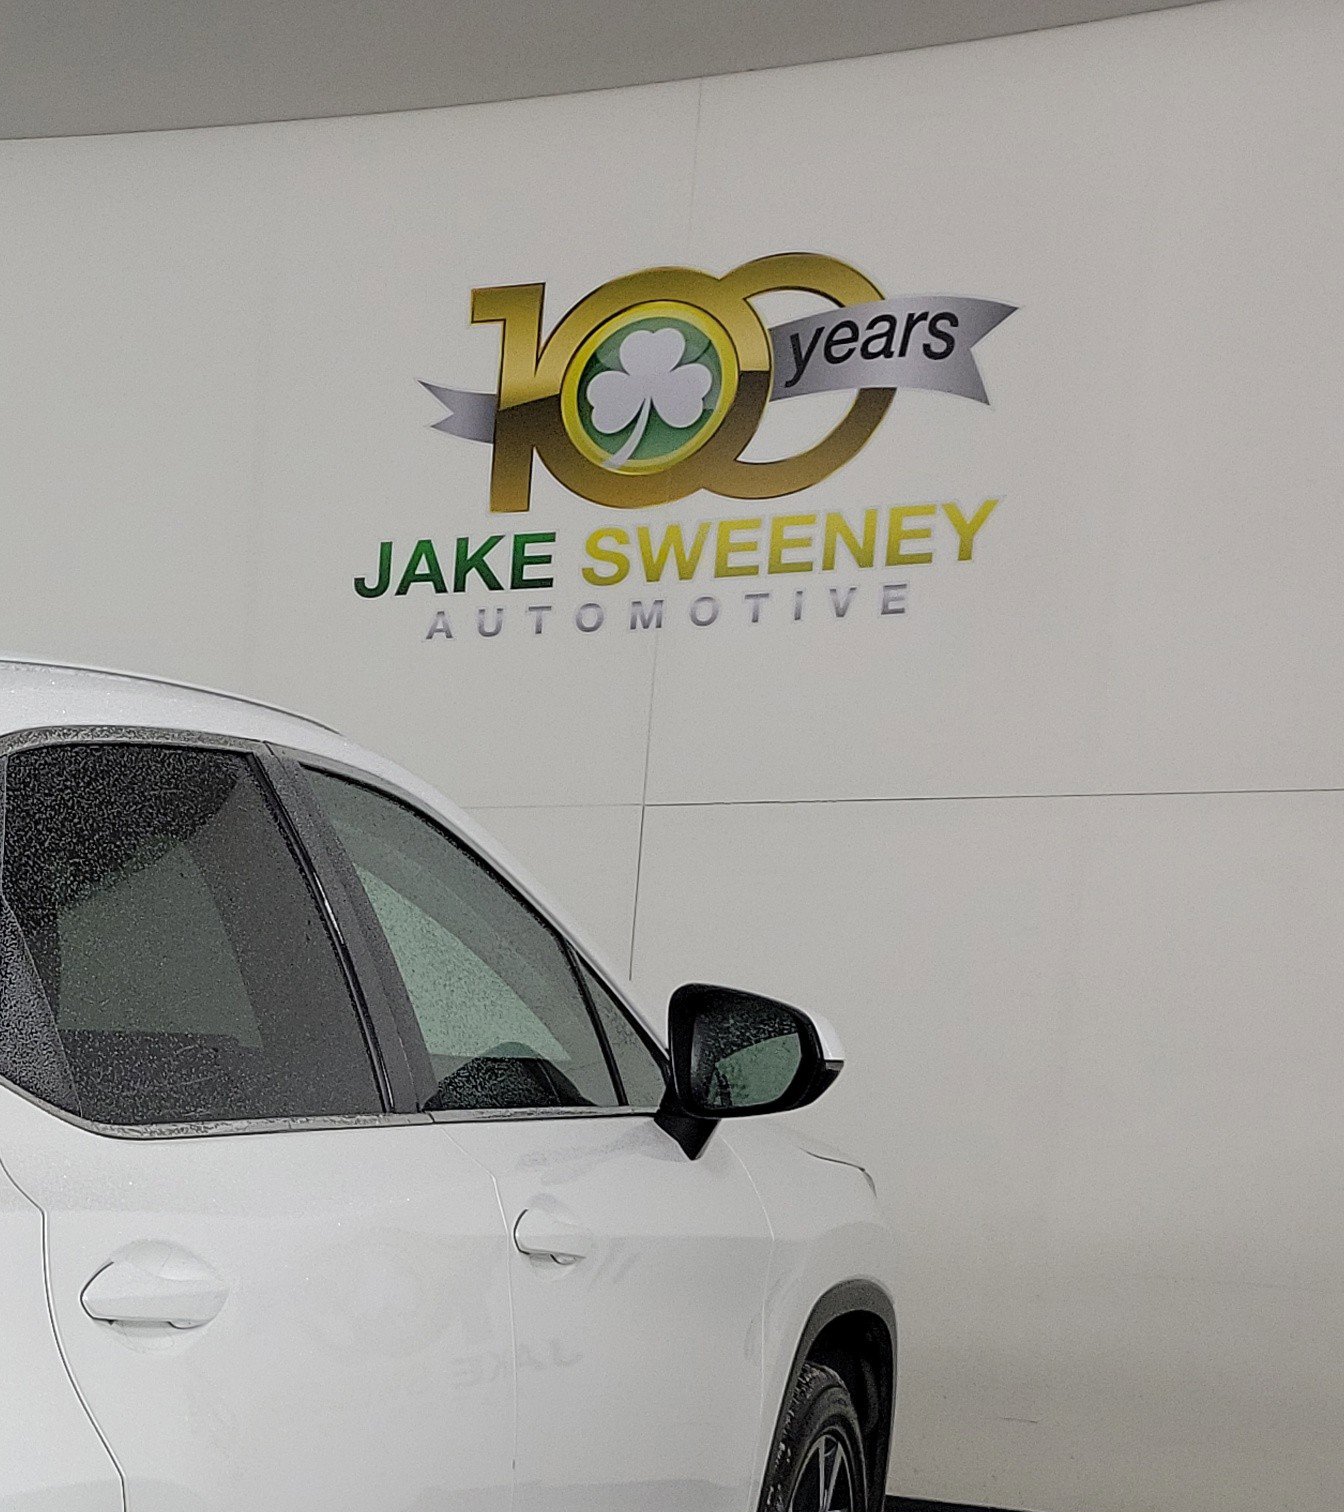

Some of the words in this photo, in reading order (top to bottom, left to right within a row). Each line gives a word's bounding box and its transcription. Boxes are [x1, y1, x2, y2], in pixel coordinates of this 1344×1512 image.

[471, 252, 897, 514] 100
[784, 310, 960, 389] years
[353, 532, 557, 600] JAKE
[581, 499, 1003, 588] SWEENEY
[425, 583, 908, 641] AUTOMOTIVE
